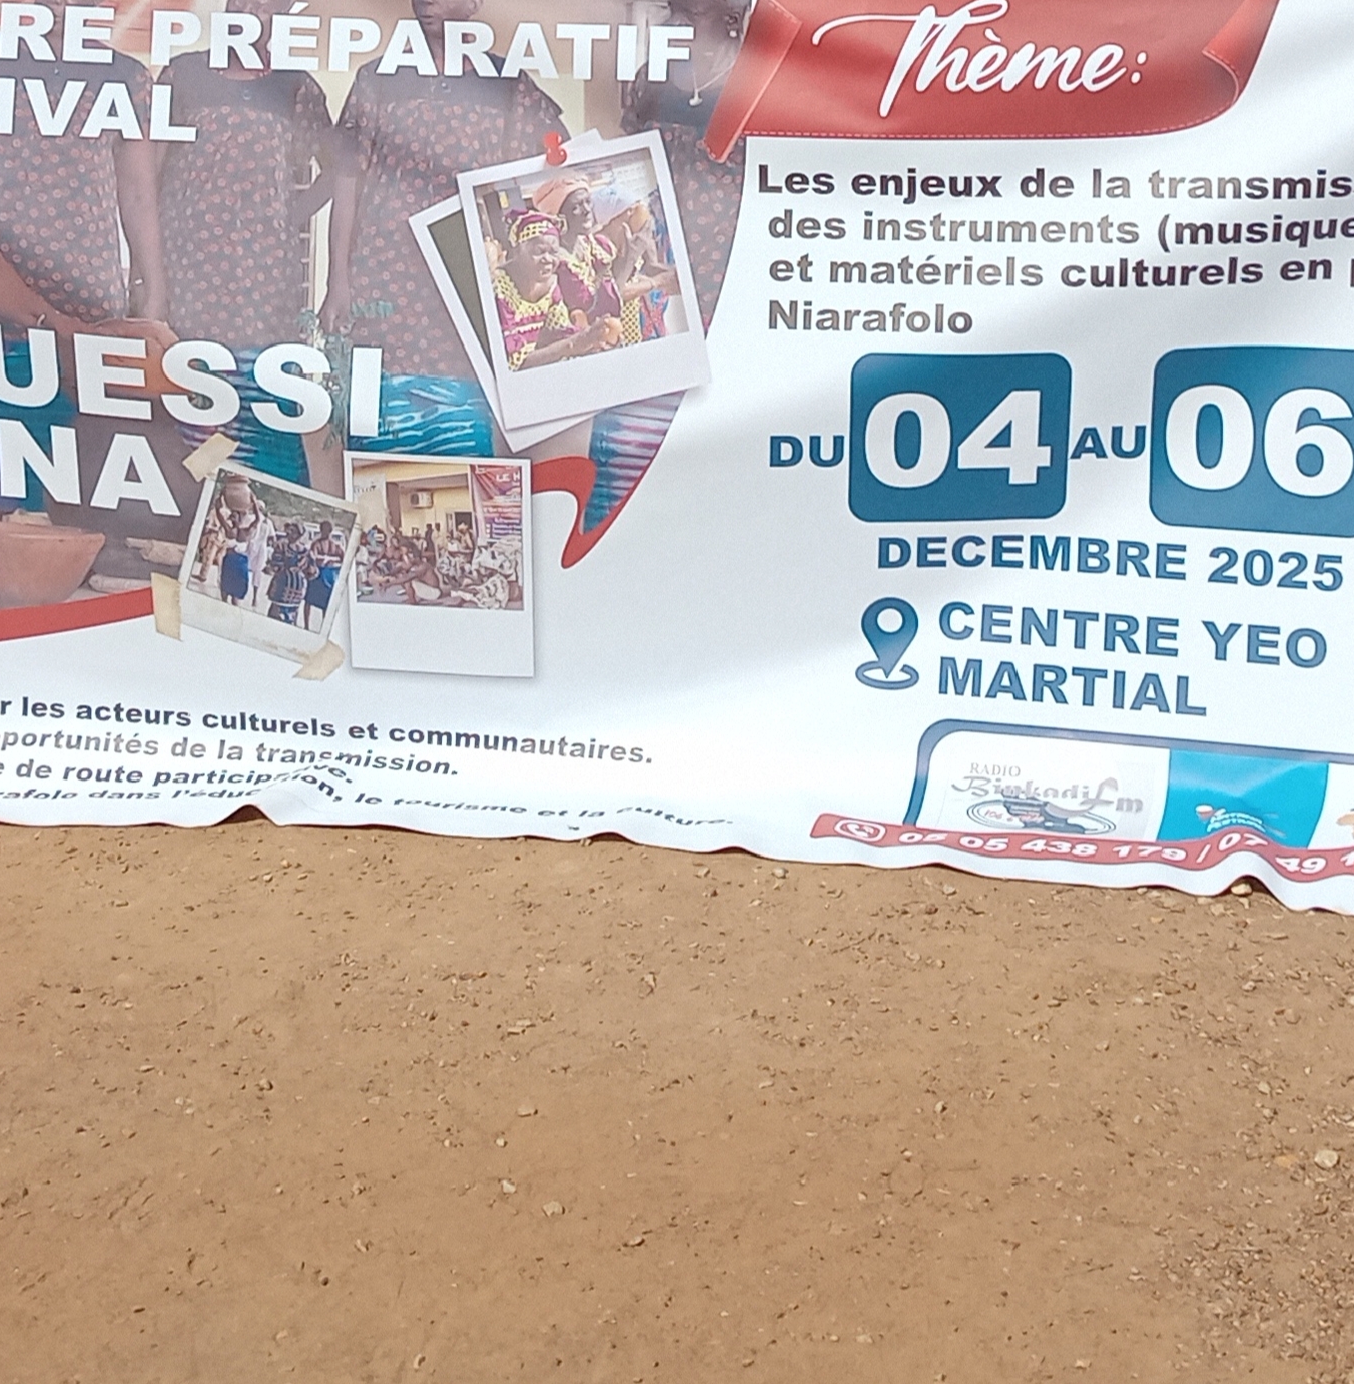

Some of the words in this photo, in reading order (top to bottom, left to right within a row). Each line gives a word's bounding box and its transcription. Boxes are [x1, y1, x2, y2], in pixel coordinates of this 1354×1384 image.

[150, 2, 695, 82] PRÉPARATIF
[758, 162, 835, 196] Les
[851, 168, 1001, 204] enjeux
[1018, 166, 1075, 199] de
[1093, 168, 1131, 199] la
[767, 209, 847, 241] des
[862, 211, 1141, 245] instruments
[768, 253, 814, 284] et
[829, 253, 1045, 287] matériels
[1060, 255, 1265, 289] culturels
[1279, 257, 1333, 282] en
[768, 299, 974, 335] Niarafolo
[768, 433, 845, 468] DU
[863, 388, 1052, 489] 04
[1070, 425, 1147, 460] AU
[877, 534, 1187, 581] DECEMBRE
[1208, 546, 1345, 593] 2025
[937, 600, 1179, 658] CENTRE
[1201, 619, 1328, 669] YEO
[938, 656, 1208, 717] MARTIAL
[21, 696, 66, 719] les
[75, 702, 192, 727] acteurs
[201, 708, 336, 738] culturels
[348, 722, 379, 741] et
[388, 726, 653, 765] communautaires.
[15, 758, 53, 780] de
[62, 765, 144, 785] route
[170, 736, 207, 760] de
[216, 738, 243, 761] la
[255, 741, 459, 776] transmission.
[969, 762, 1022, 778] RADIO
[88, 789, 161, 800] dans
[354, 792, 383, 806] le
[394, 796, 528, 815] tourisme
[958, 835, 1010, 852] 05
[1020, 838, 1099, 858] 438
[1112, 844, 1187, 863] 179
[1217, 832, 1269, 852] 07
[1275, 856, 1327, 875] 49
